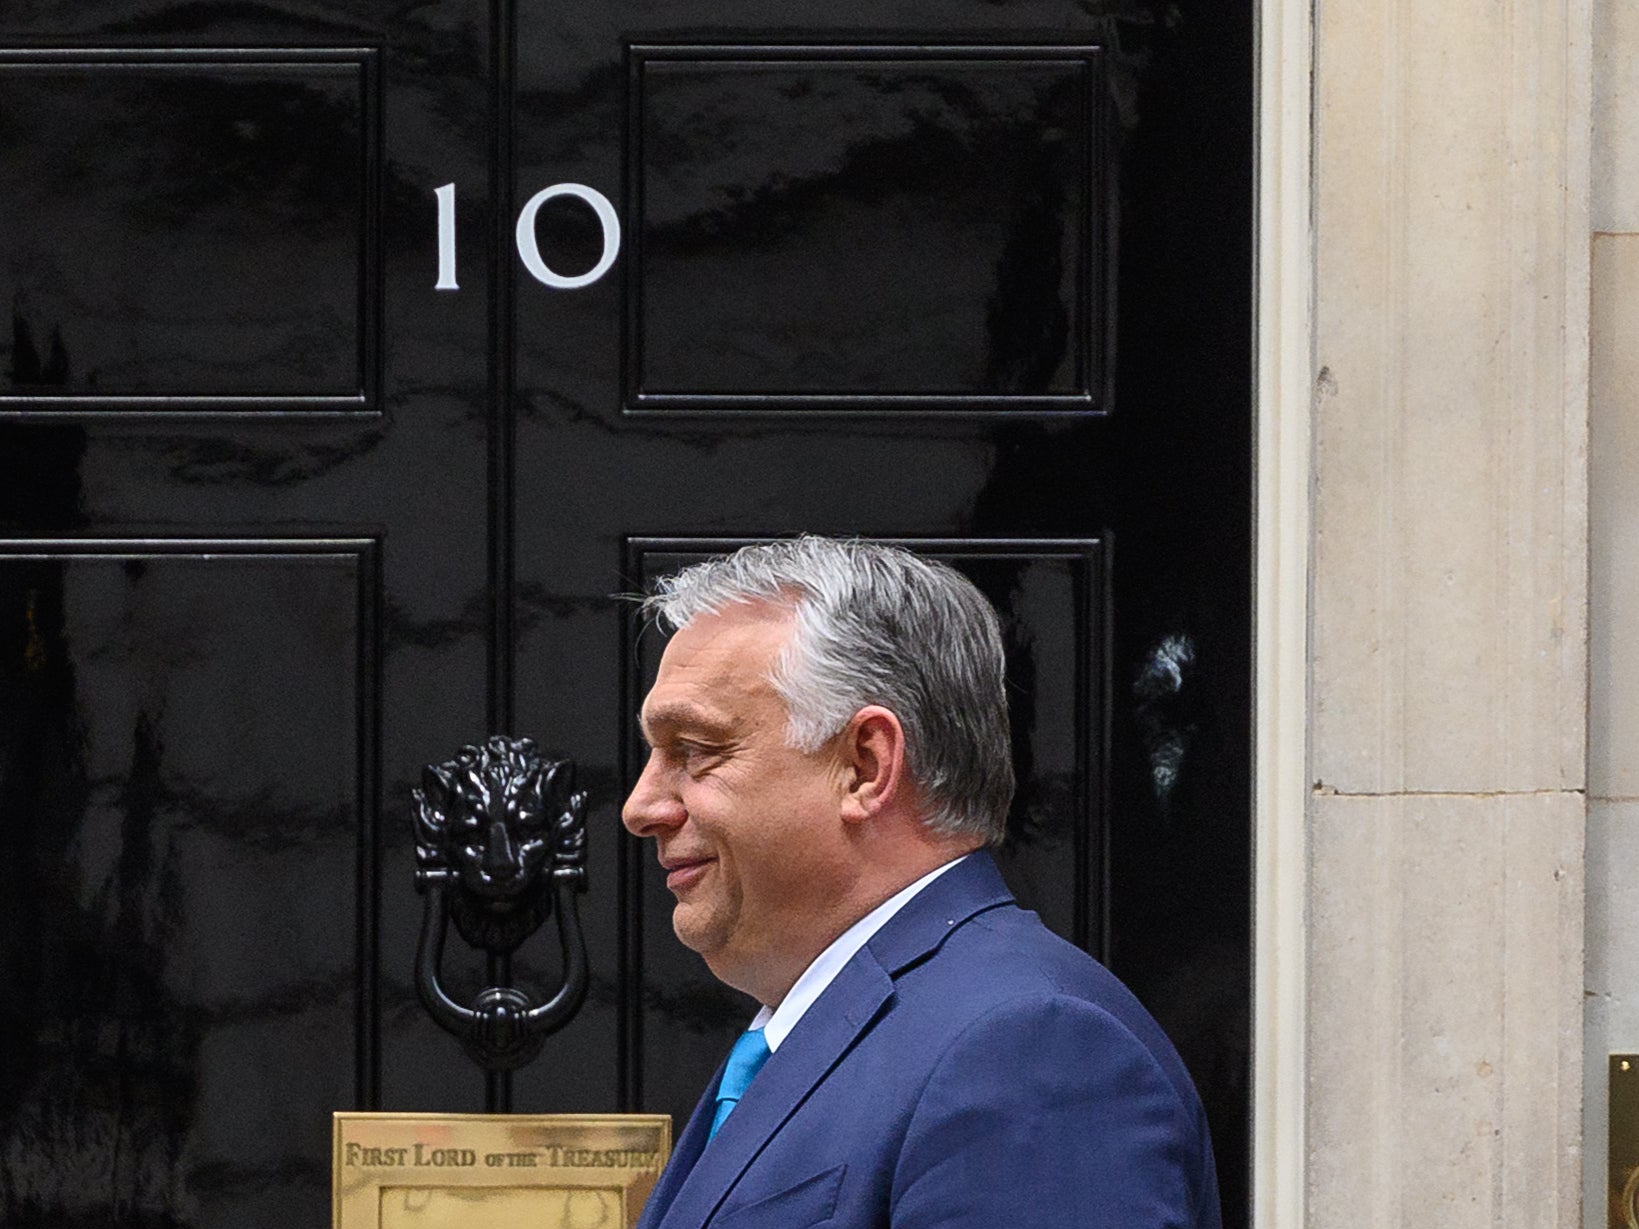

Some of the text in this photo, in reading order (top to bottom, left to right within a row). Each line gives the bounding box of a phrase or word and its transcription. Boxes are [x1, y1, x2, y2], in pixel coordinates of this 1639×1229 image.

[433, 182, 621, 290] 10
[345, 1142, 408, 1167] FIRST
[413, 1142, 476, 1167] LORD
[485, 1153, 505, 1167] OF
[507, 1153, 537, 1167] THE
